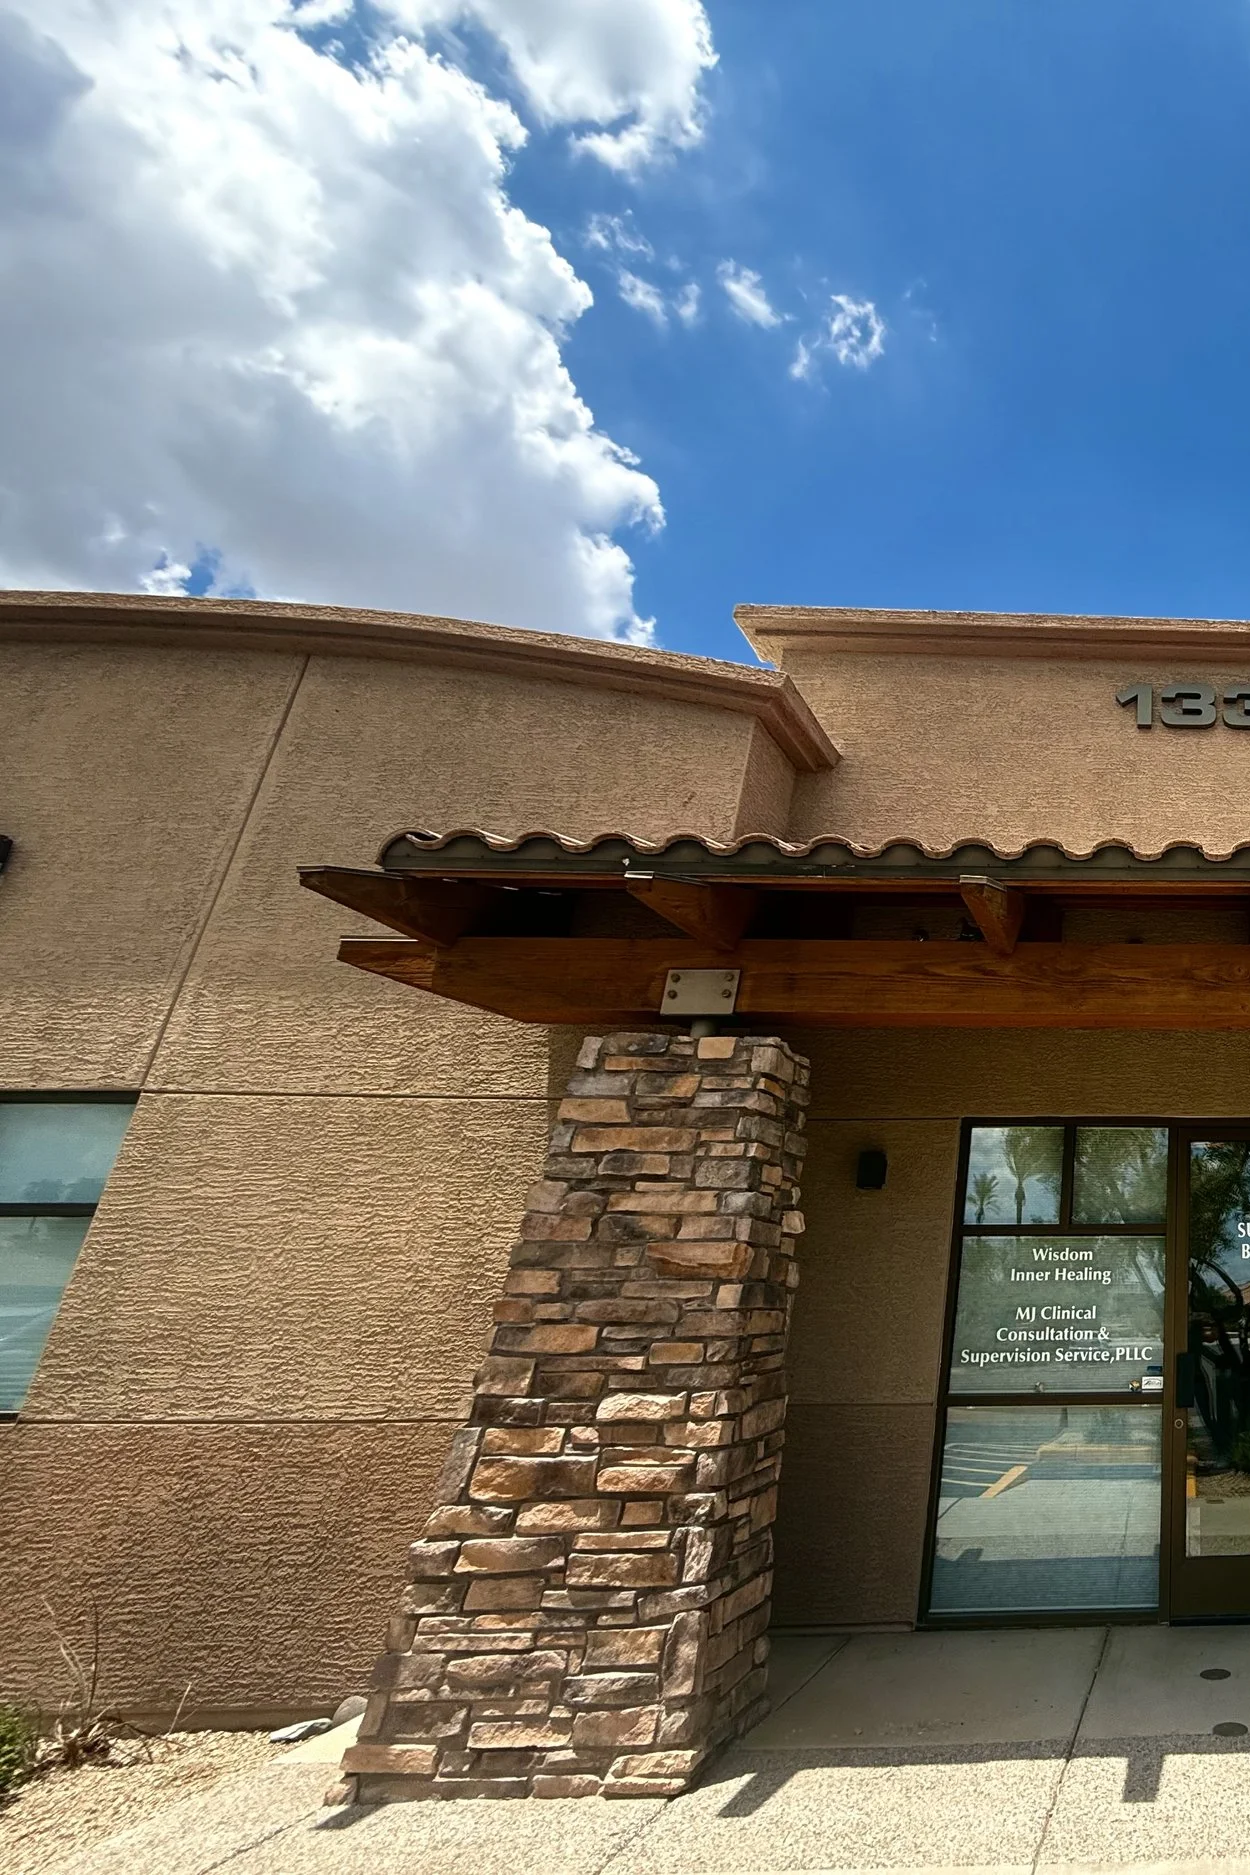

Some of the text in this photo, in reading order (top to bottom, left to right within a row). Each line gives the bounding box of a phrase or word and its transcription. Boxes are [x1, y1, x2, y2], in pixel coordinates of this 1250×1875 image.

[1032, 1248, 1093, 1261] Wisdom
[1010, 1267, 1112, 1285] Inner Healing
[1015, 1305, 1096, 1322] MJ Clinical
[996, 1326, 1110, 1342] Consultation &
[960, 1348, 1050, 1367] Supervision
